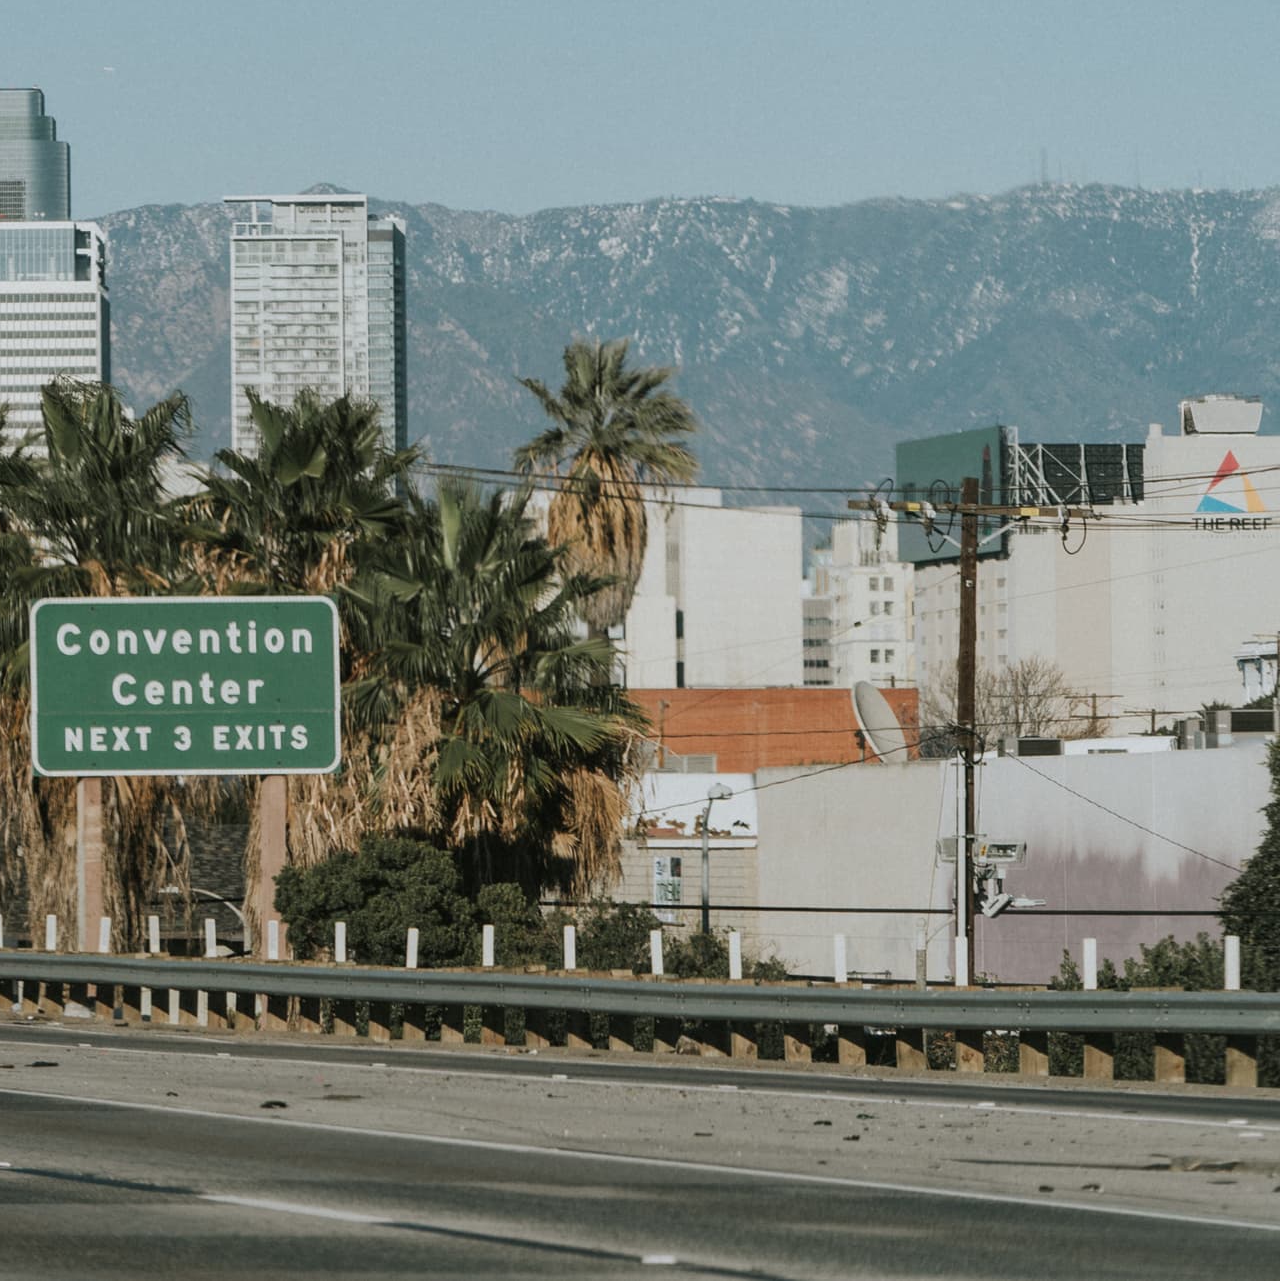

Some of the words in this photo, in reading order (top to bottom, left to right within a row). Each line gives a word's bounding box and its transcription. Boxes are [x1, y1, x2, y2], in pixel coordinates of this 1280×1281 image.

[1192, 517, 1224, 530] THE
[1229, 517, 1272, 530] REEF
[55, 620, 313, 656] Convention
[111, 672, 265, 706] Center
[64, 726, 152, 752] NEXT
[173, 725, 192, 752] 3
[213, 725, 309, 751] EXITS
